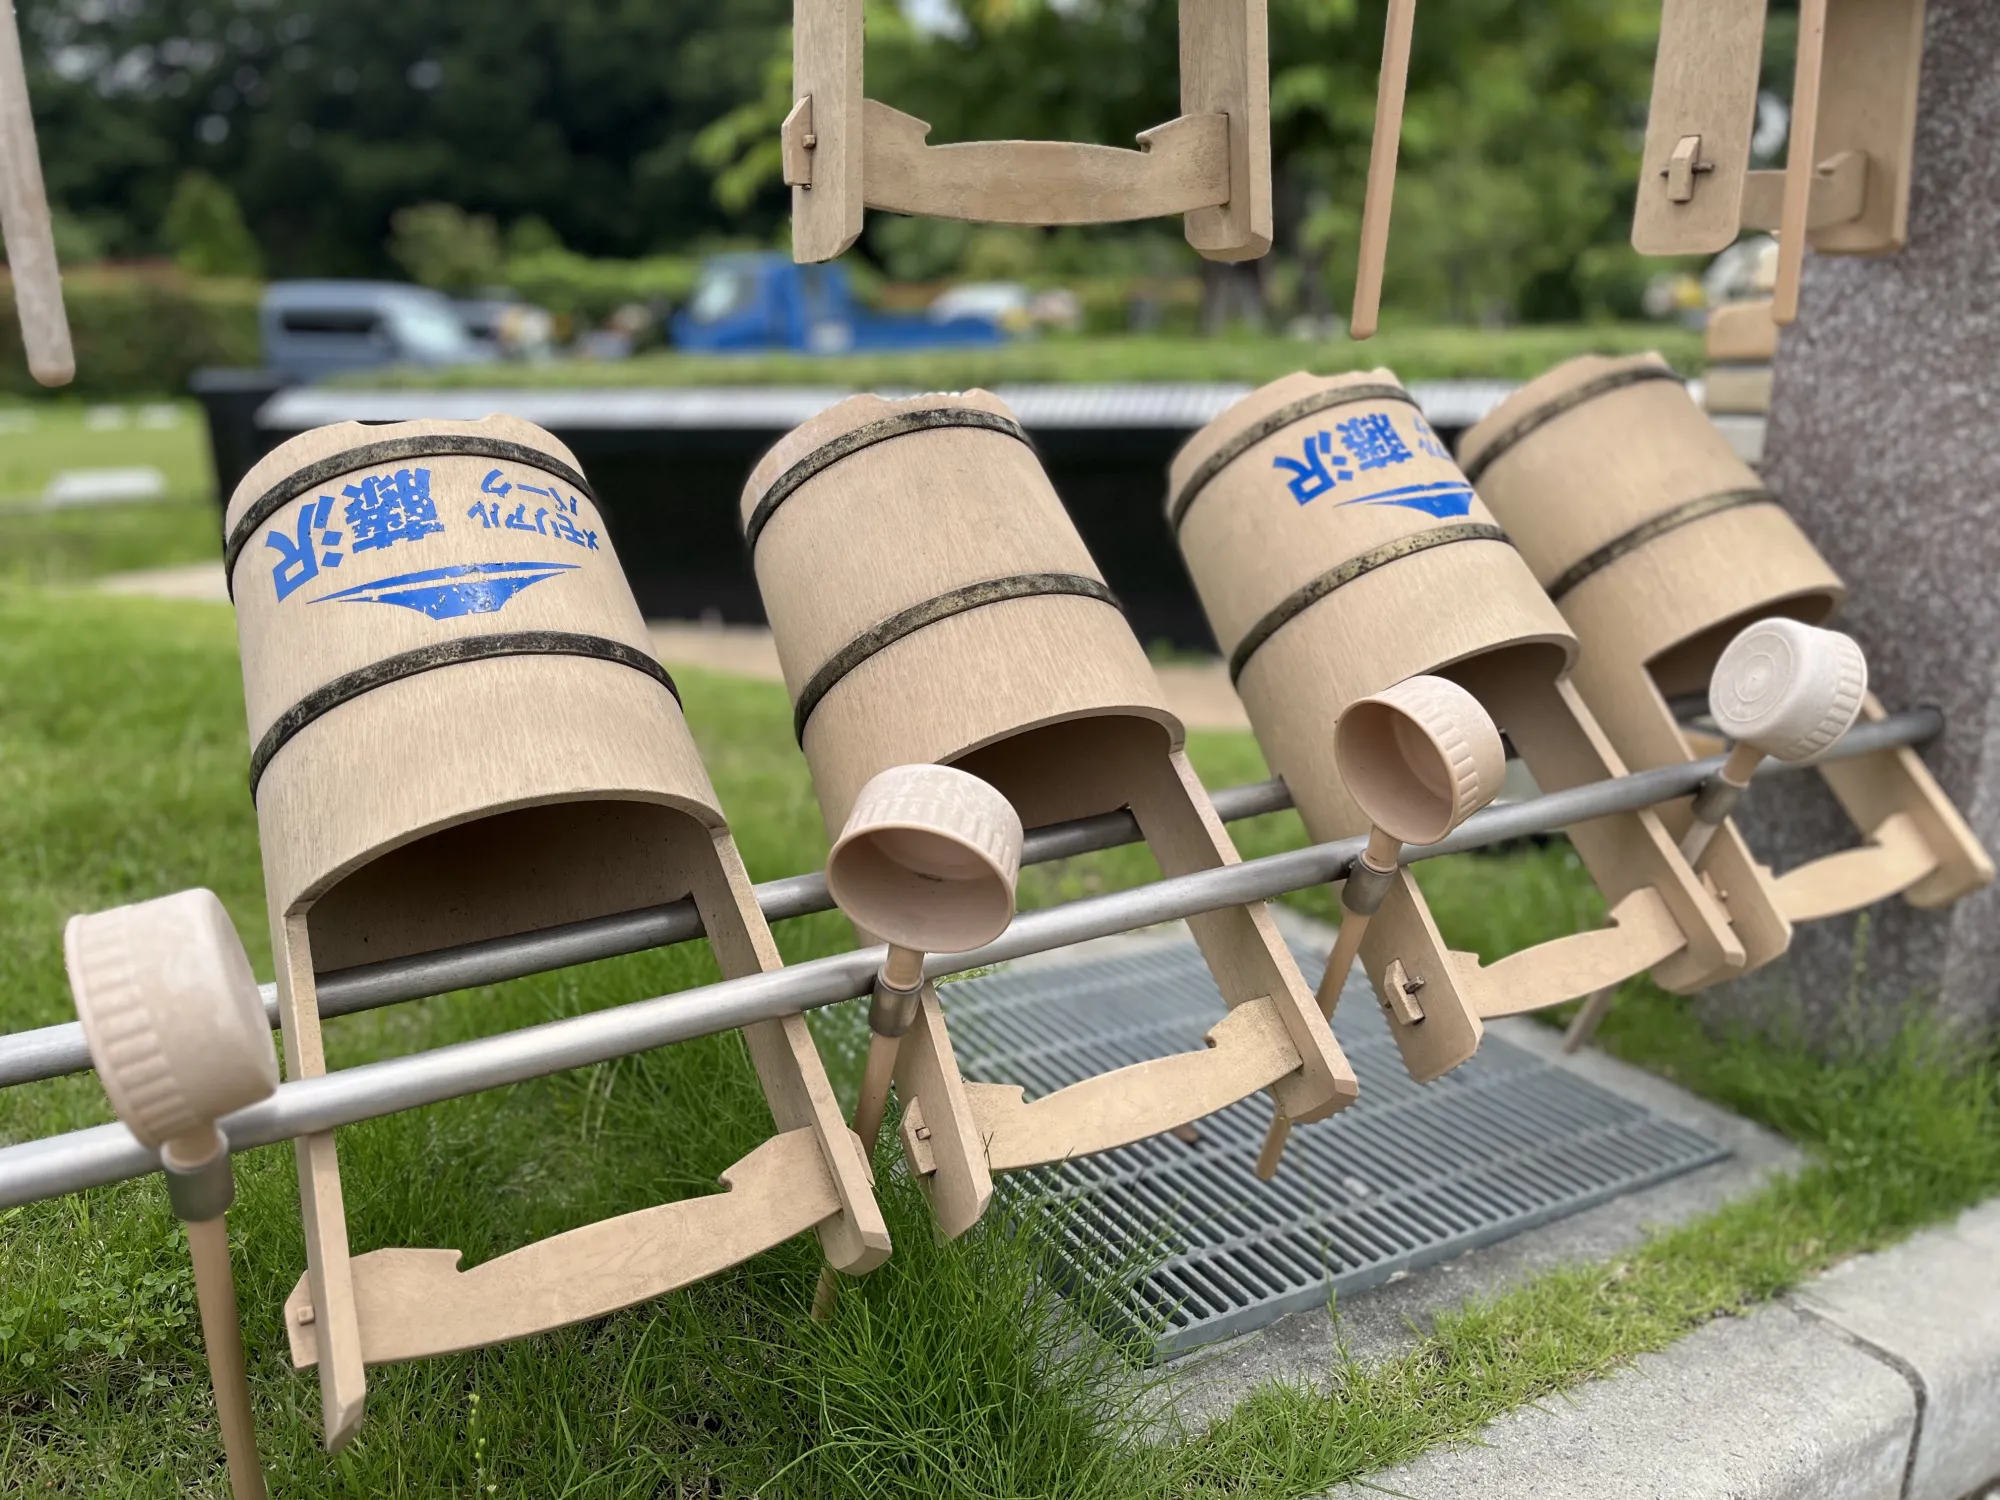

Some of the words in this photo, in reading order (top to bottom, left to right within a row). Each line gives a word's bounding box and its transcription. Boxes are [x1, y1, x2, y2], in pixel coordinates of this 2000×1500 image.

[1272, 413, 1414, 507] 藤沢
[266, 468, 444, 603] 藤沢
[467, 500, 599, 550] メモリアル
